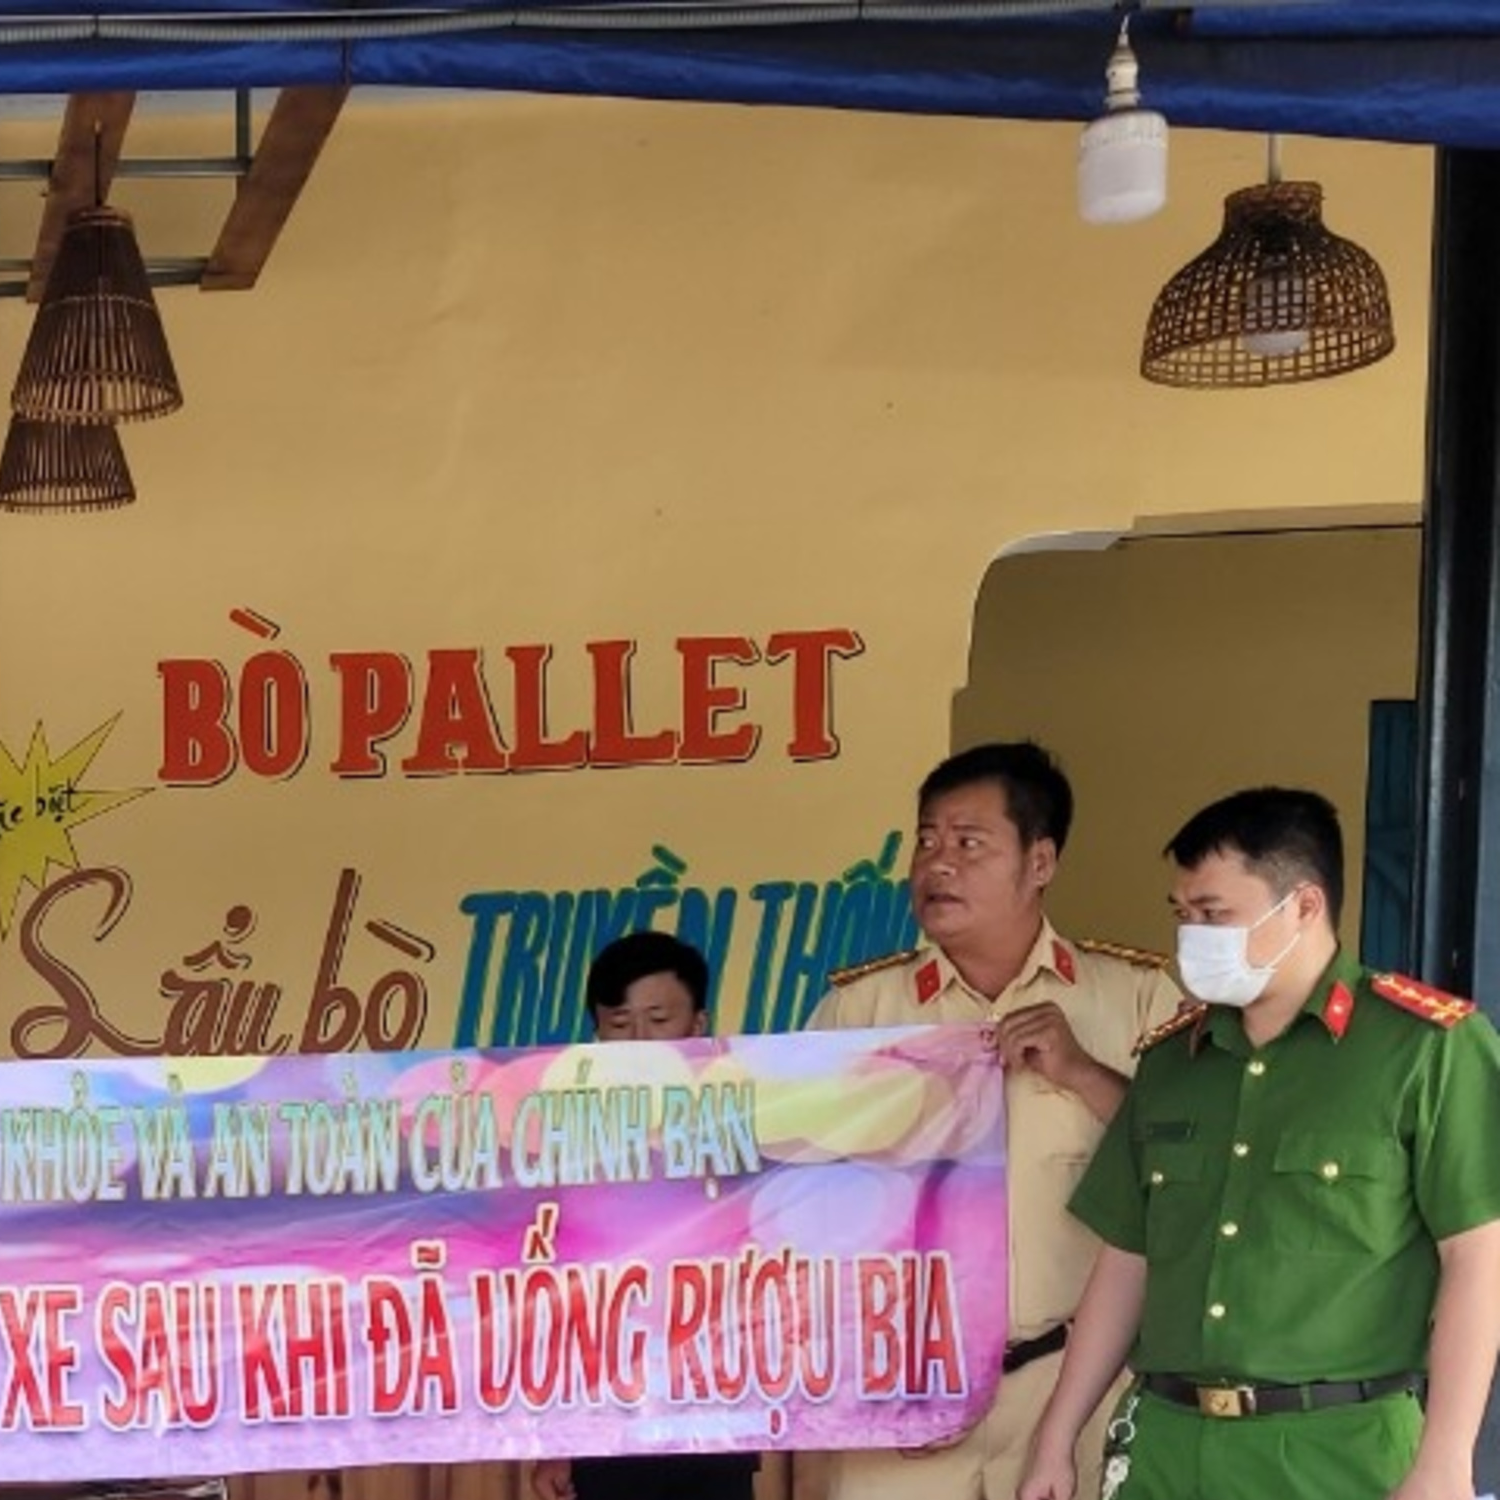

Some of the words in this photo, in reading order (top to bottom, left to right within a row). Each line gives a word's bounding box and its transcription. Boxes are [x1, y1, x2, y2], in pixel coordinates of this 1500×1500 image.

[157, 608, 310, 788] BÒ
[329, 628, 865, 780] PALLET
[299, 867, 436, 1054] bò
[1, 1072, 126, 1202] KHỎE
[136, 1073, 198, 1200] VÀ
[203, 1103, 272, 1197] AN
[280, 1070, 399, 1196] TOÀN
[409, 1062, 501, 1194] CỦA
[511, 1058, 651, 1187] CHÍNH
[661, 1078, 762, 1199] BẠN
[98, 1281, 220, 1432] SAU
[238, 1278, 350, 1420] KHI
[365, 1240, 460, 1416] ĐÃ
[470, 1203, 648, 1412] UỐNG
[663, 1247, 838, 1439] RƯỢU
[857, 1250, 967, 1398] BIA
